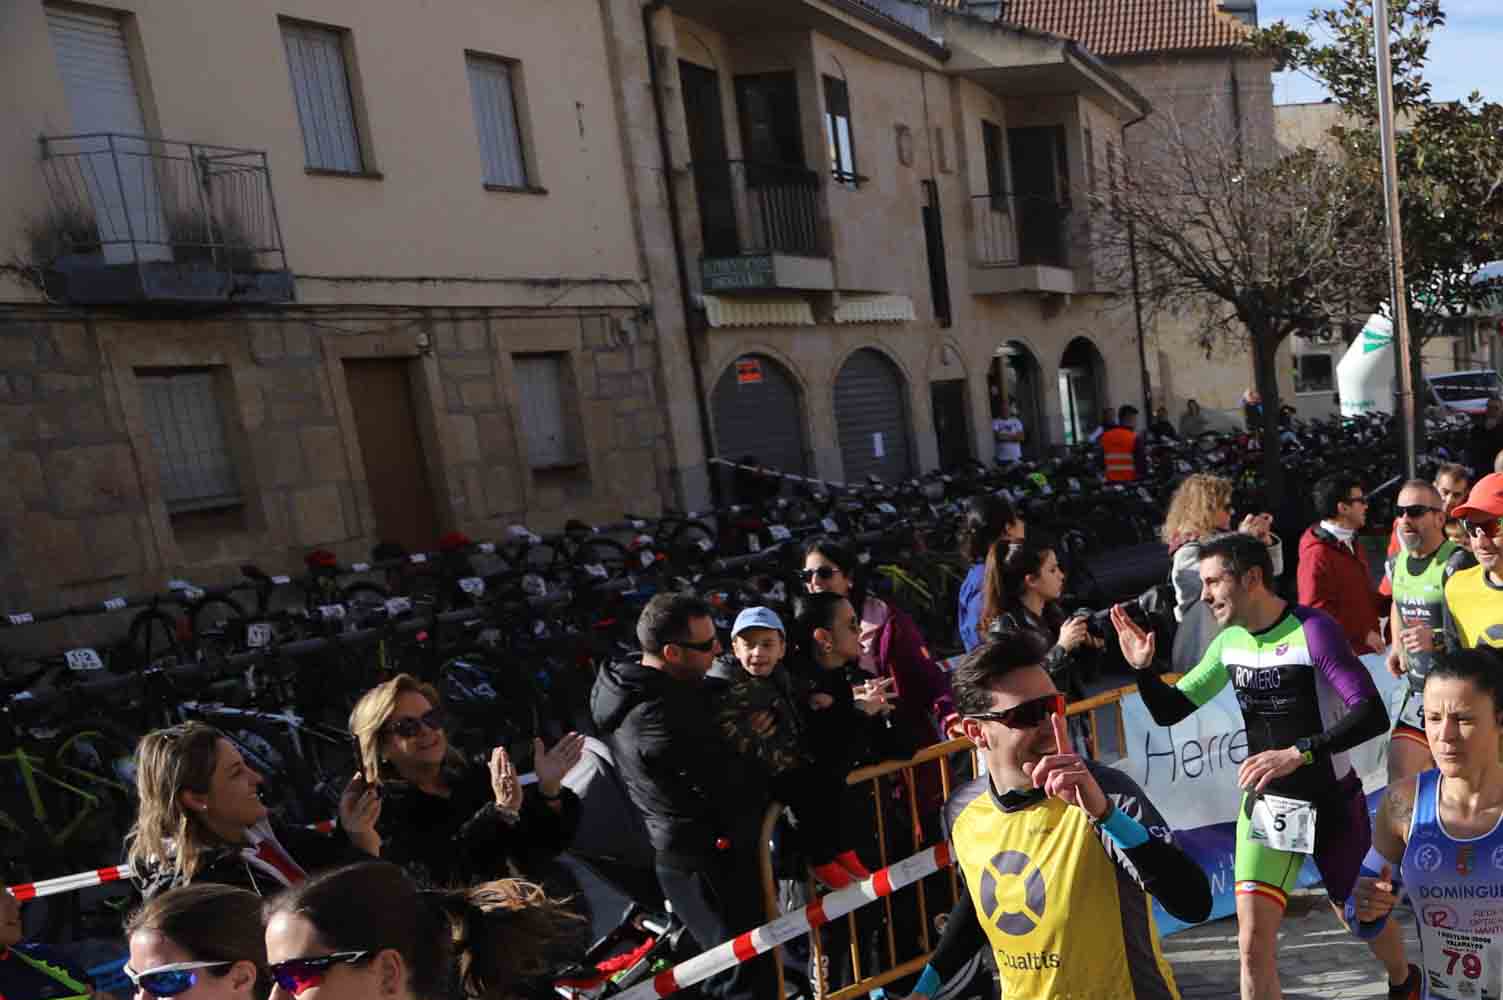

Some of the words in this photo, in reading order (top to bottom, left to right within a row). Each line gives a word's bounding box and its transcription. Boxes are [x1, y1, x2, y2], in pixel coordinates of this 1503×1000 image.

[1235, 666, 1281, 690] ROMERO
[1272, 813, 1287, 833] 5
[998, 950, 1062, 972] Cualtis
[1442, 948, 1483, 980] 79
